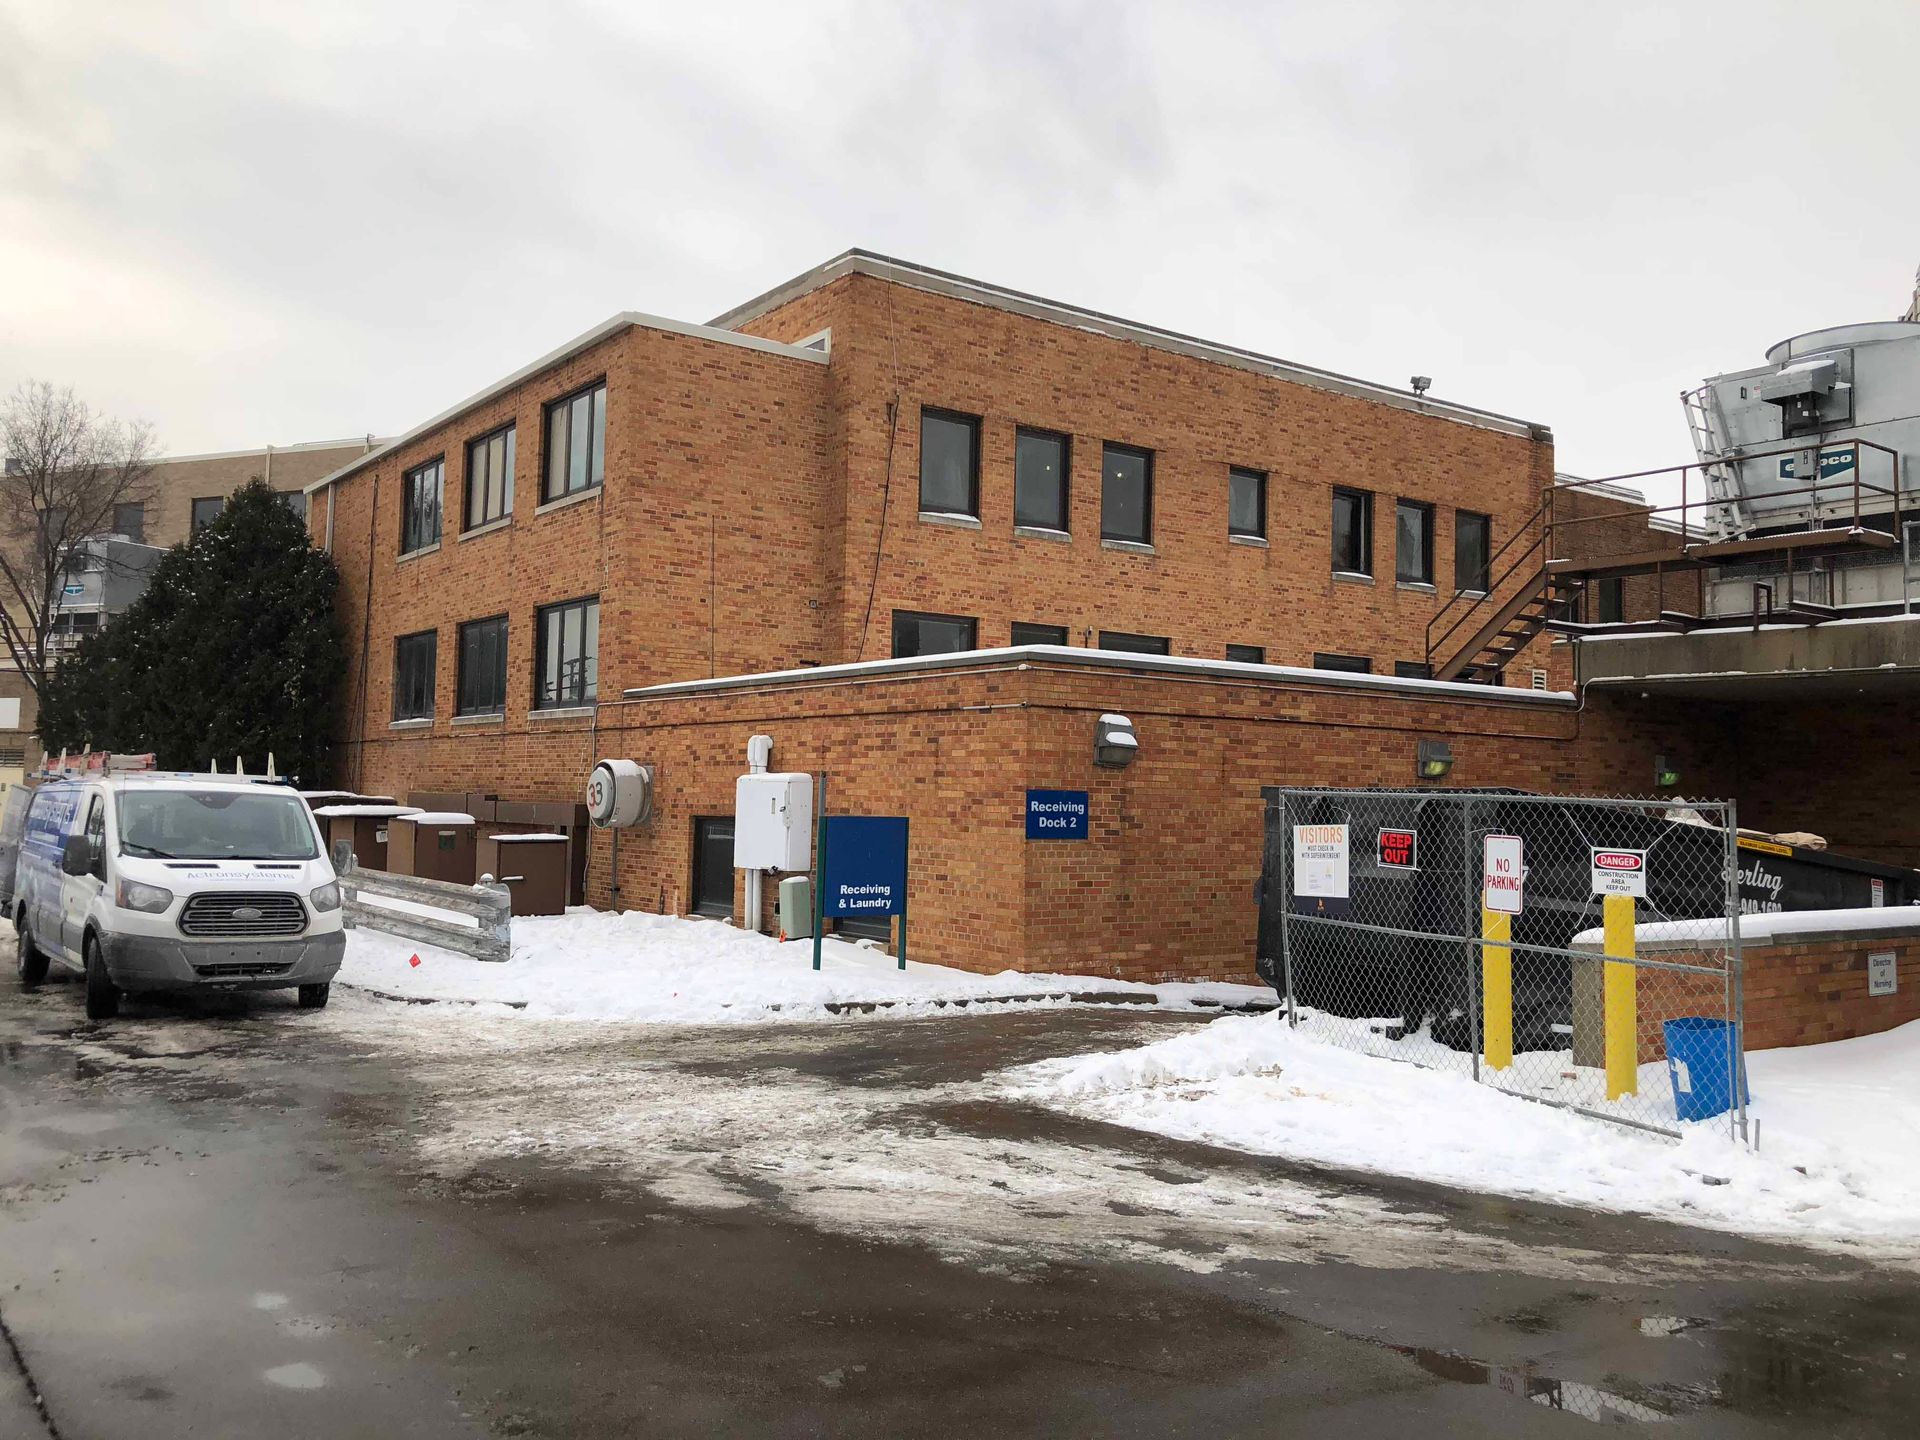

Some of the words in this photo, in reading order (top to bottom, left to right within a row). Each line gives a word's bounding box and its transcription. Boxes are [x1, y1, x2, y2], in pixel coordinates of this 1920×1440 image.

[1031, 801, 1085, 815] Receiving
[1039, 816, 1067, 828] Dock
[1070, 817, 1077, 828] 2
[1299, 827, 1343, 844] VISITORS
[1381, 833, 1412, 848] KEEP
[1384, 848, 1408, 864] OUT
[1600, 856, 1635, 867] DANGER
[1496, 858, 1510, 873] NO
[1598, 871, 1639, 879] CONSTRUCTION
[1721, 858, 1784, 900] erling
[1487, 874, 1519, 891] PARKING
[840, 884, 891, 896] Receiving
[838, 898, 847, 908] &
[850, 897, 892, 909] Laundry
